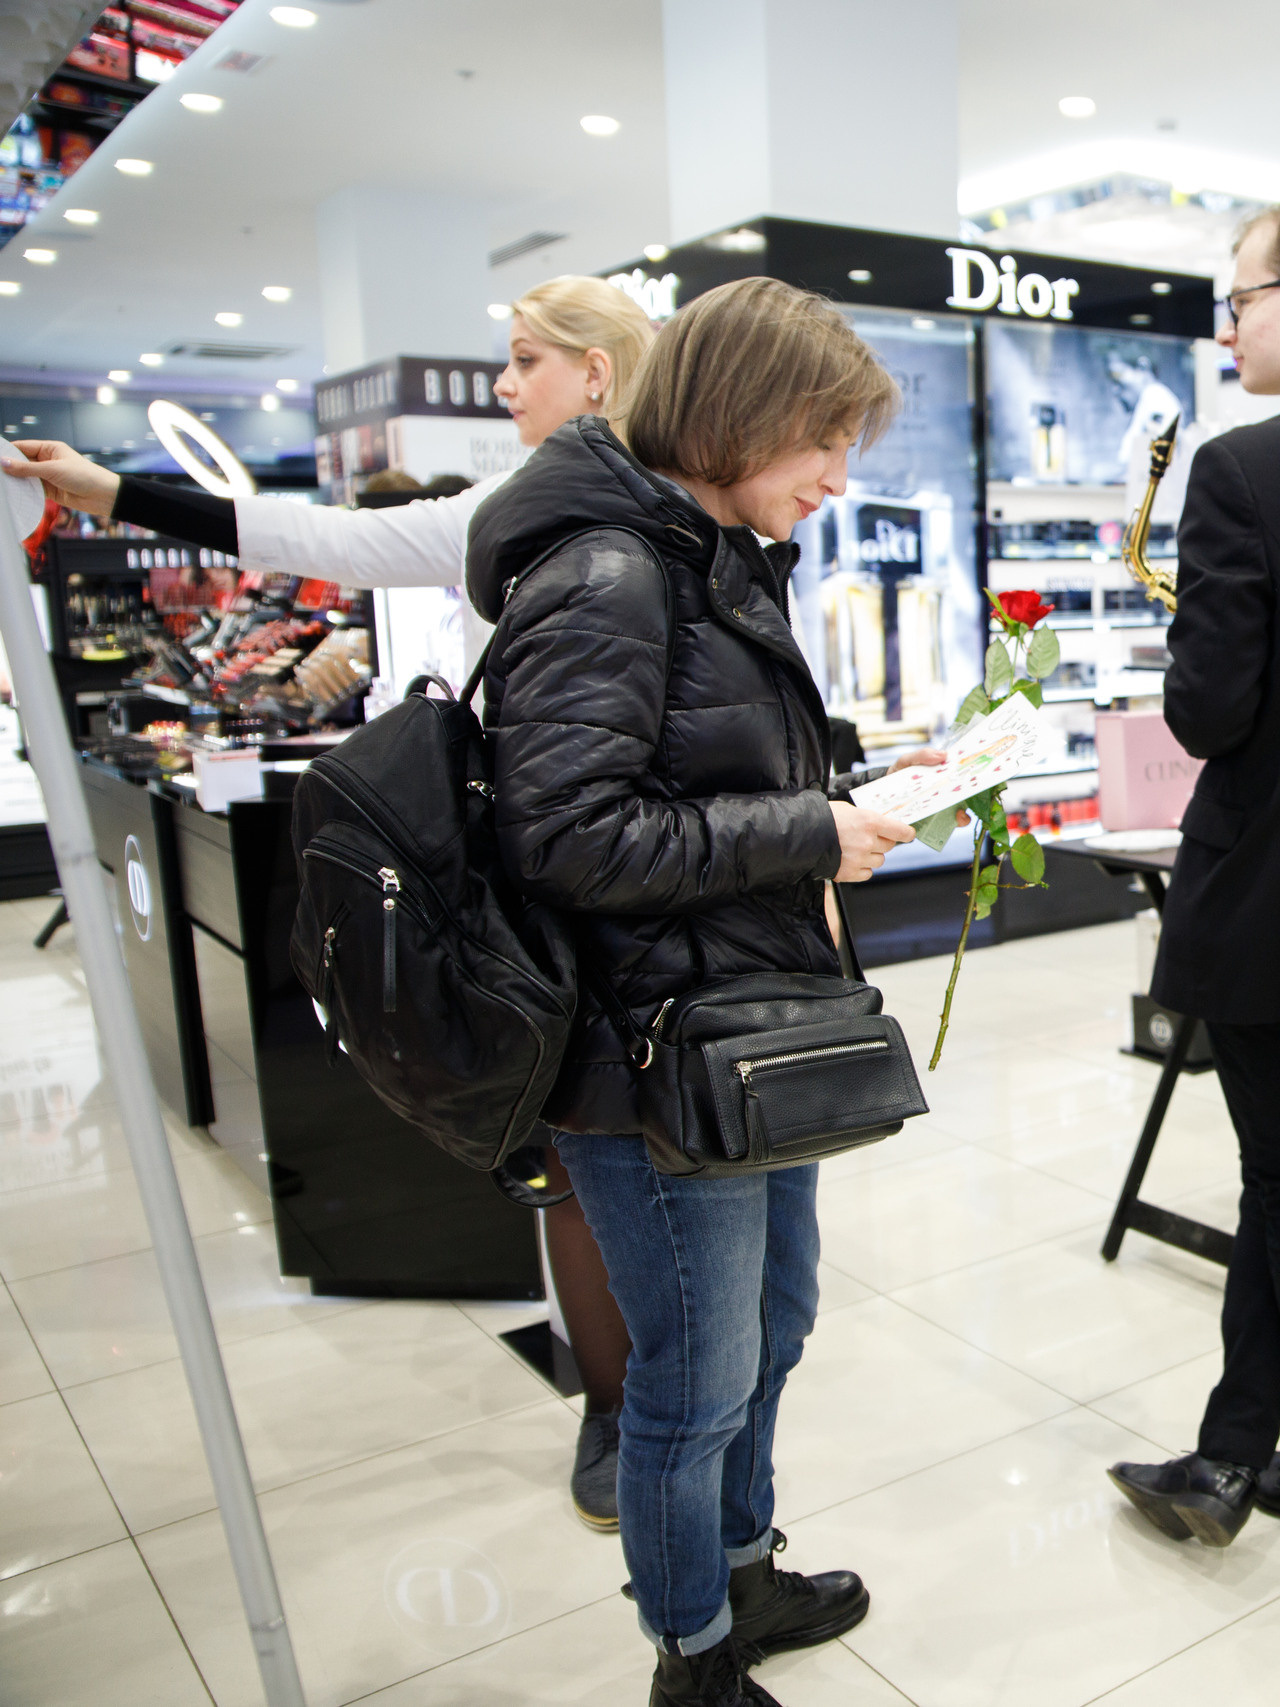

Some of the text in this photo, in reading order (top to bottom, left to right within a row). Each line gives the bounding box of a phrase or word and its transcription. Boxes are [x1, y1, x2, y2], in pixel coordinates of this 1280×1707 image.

[945, 247, 1080, 320] Dior
[424, 368, 508, 408] BOB
[1144, 760, 1199, 782] CLINI
